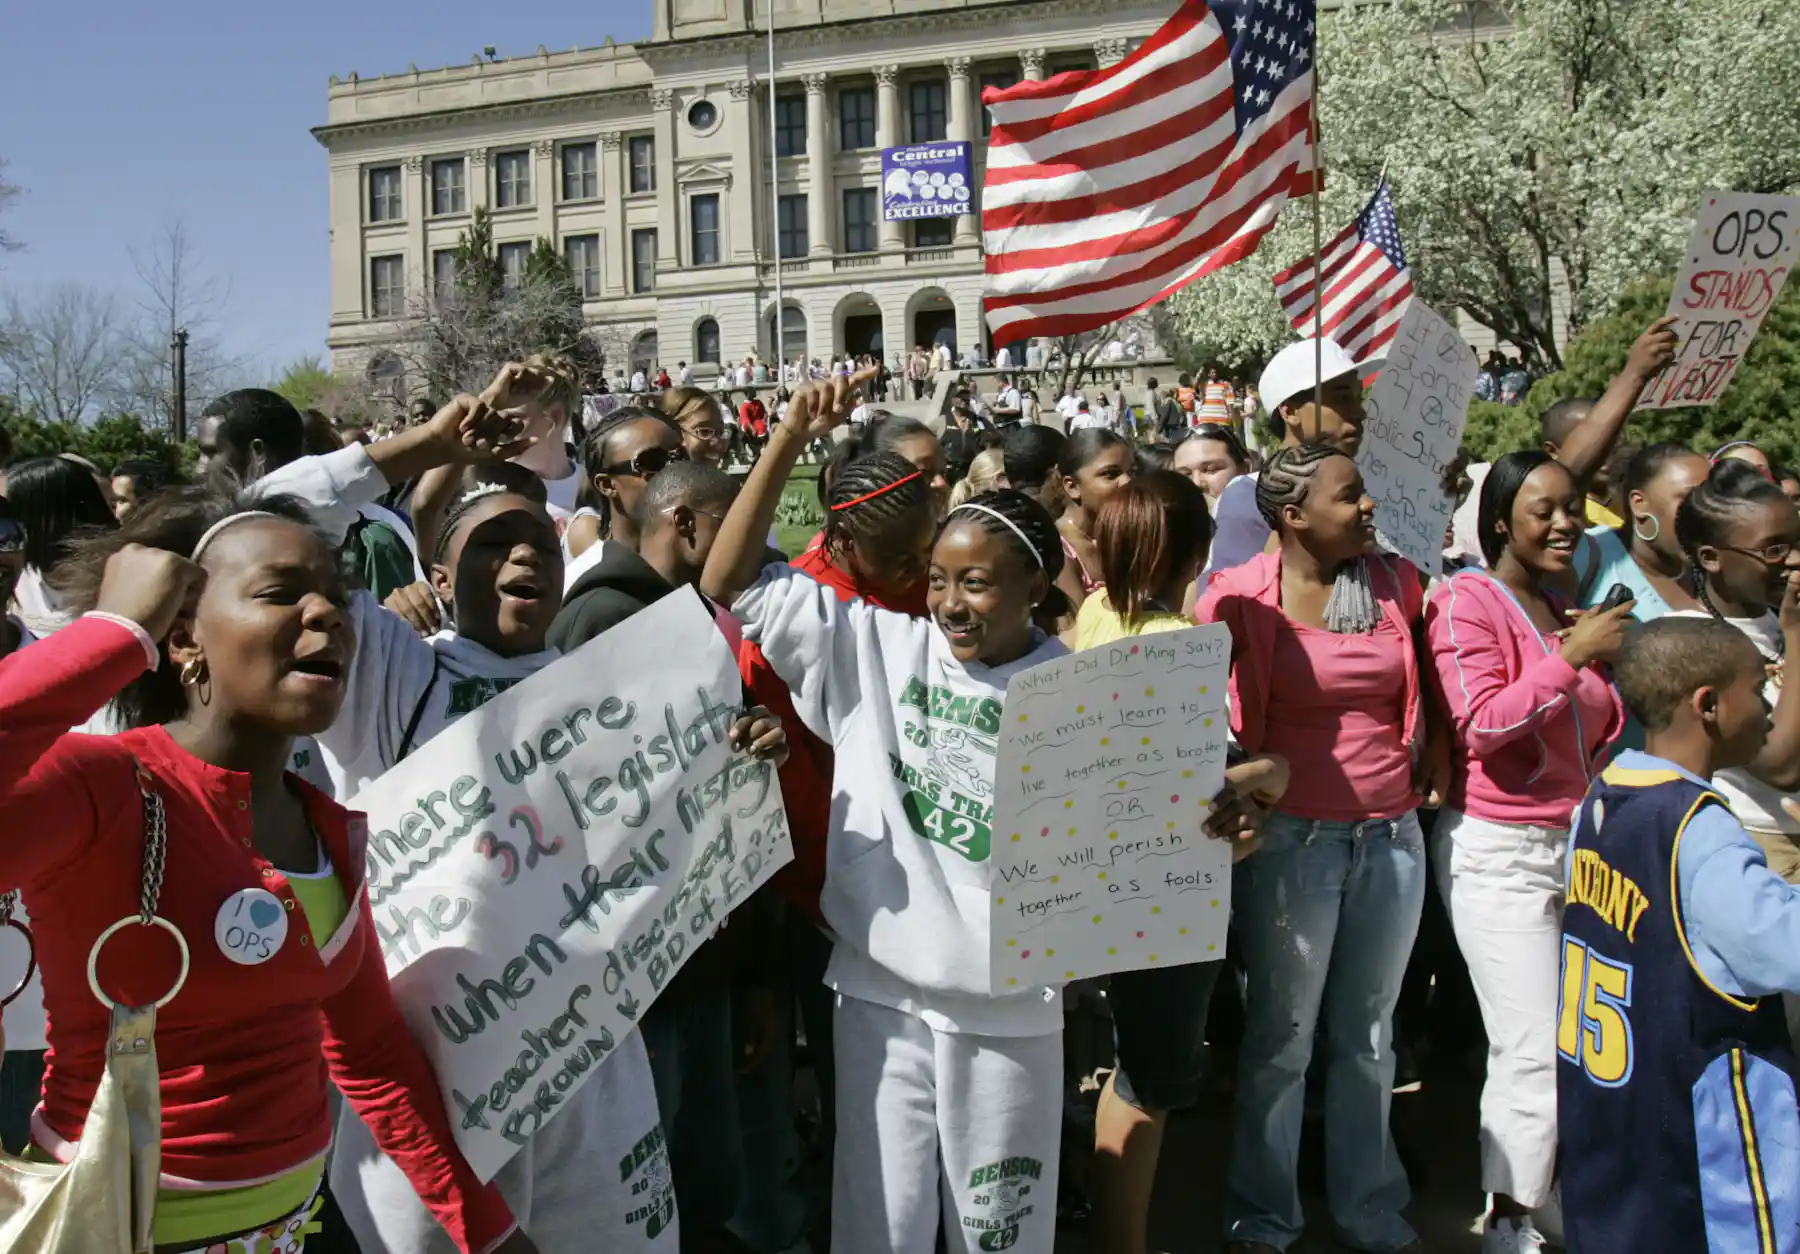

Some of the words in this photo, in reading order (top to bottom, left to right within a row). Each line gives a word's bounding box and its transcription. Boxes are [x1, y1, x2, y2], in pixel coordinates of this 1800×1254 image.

[892, 145, 964, 163] Central
[885, 202, 971, 219] EXCELLENCE
[1713, 209, 1788, 259] OPS
[1683, 267, 1786, 319] STANDS
[1678, 319, 1742, 358] FOR
[1017, 668, 1064, 691] What
[1074, 654, 1099, 675] Did
[1144, 647, 1176, 665] King
[904, 720, 928, 748] 20
[1056, 713, 1106, 737] must
[1120, 703, 1167, 723] learn
[1180, 701, 1199, 714] to
[495, 695, 638, 785] were
[1021, 777, 1046, 796] live
[1064, 755, 1126, 780] together
[1137, 749, 1164, 763] as
[1106, 797, 1144, 816] OR
[474, 804, 565, 886] 32
[923, 807, 976, 855] 42
[1000, 860, 1038, 884] We
[1109, 833, 1183, 867] perish
[559, 828, 670, 934] their
[1016, 891, 1083, 917] together
[1108, 879, 1141, 893] as
[234, 896, 245, 917] I
[225, 926, 274, 958] OPS
[501, 1025, 615, 1145] BROWN
[690, 883, 716, 936] of
[1557, 933, 1634, 1089] 15
[452, 984, 592, 1130] teacher
[632, 1177, 649, 1196] 20
[967, 1156, 1043, 1189] BENSON
[973, 1194, 990, 1206] 20
[962, 1216, 1001, 1230] GIRLS
[990, 1229, 1014, 1250] 42
